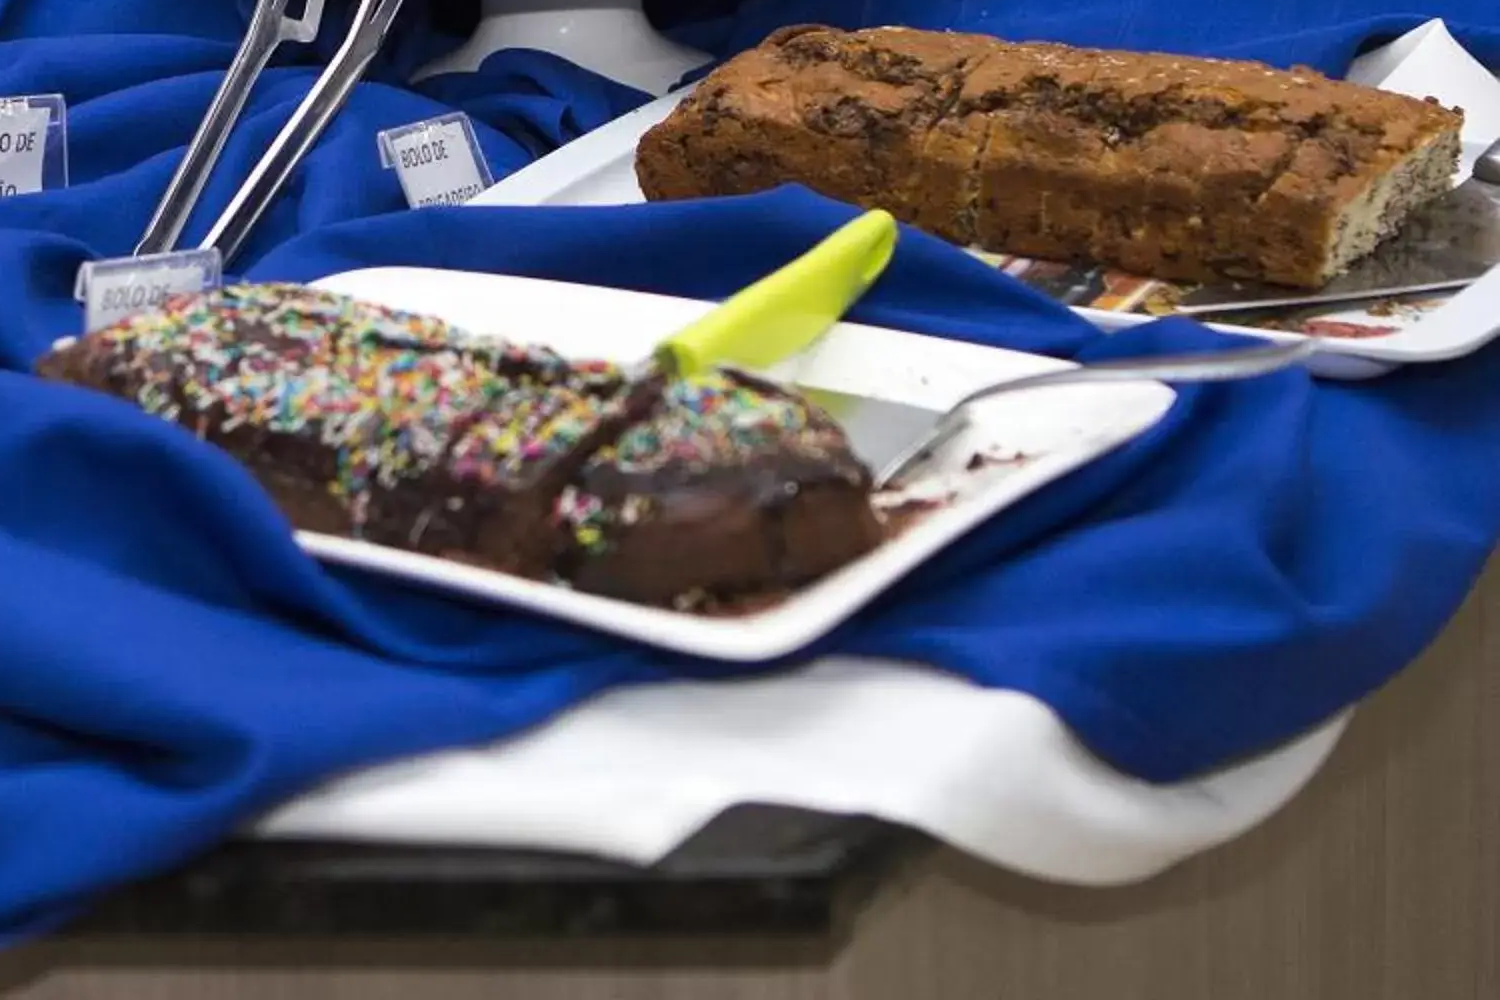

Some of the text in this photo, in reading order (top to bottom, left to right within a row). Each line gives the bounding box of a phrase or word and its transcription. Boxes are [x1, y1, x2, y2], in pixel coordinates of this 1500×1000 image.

[16, 131, 37, 152] DE
[401, 139, 448, 168] BOLO DE
[102, 285, 146, 310] BOLO
